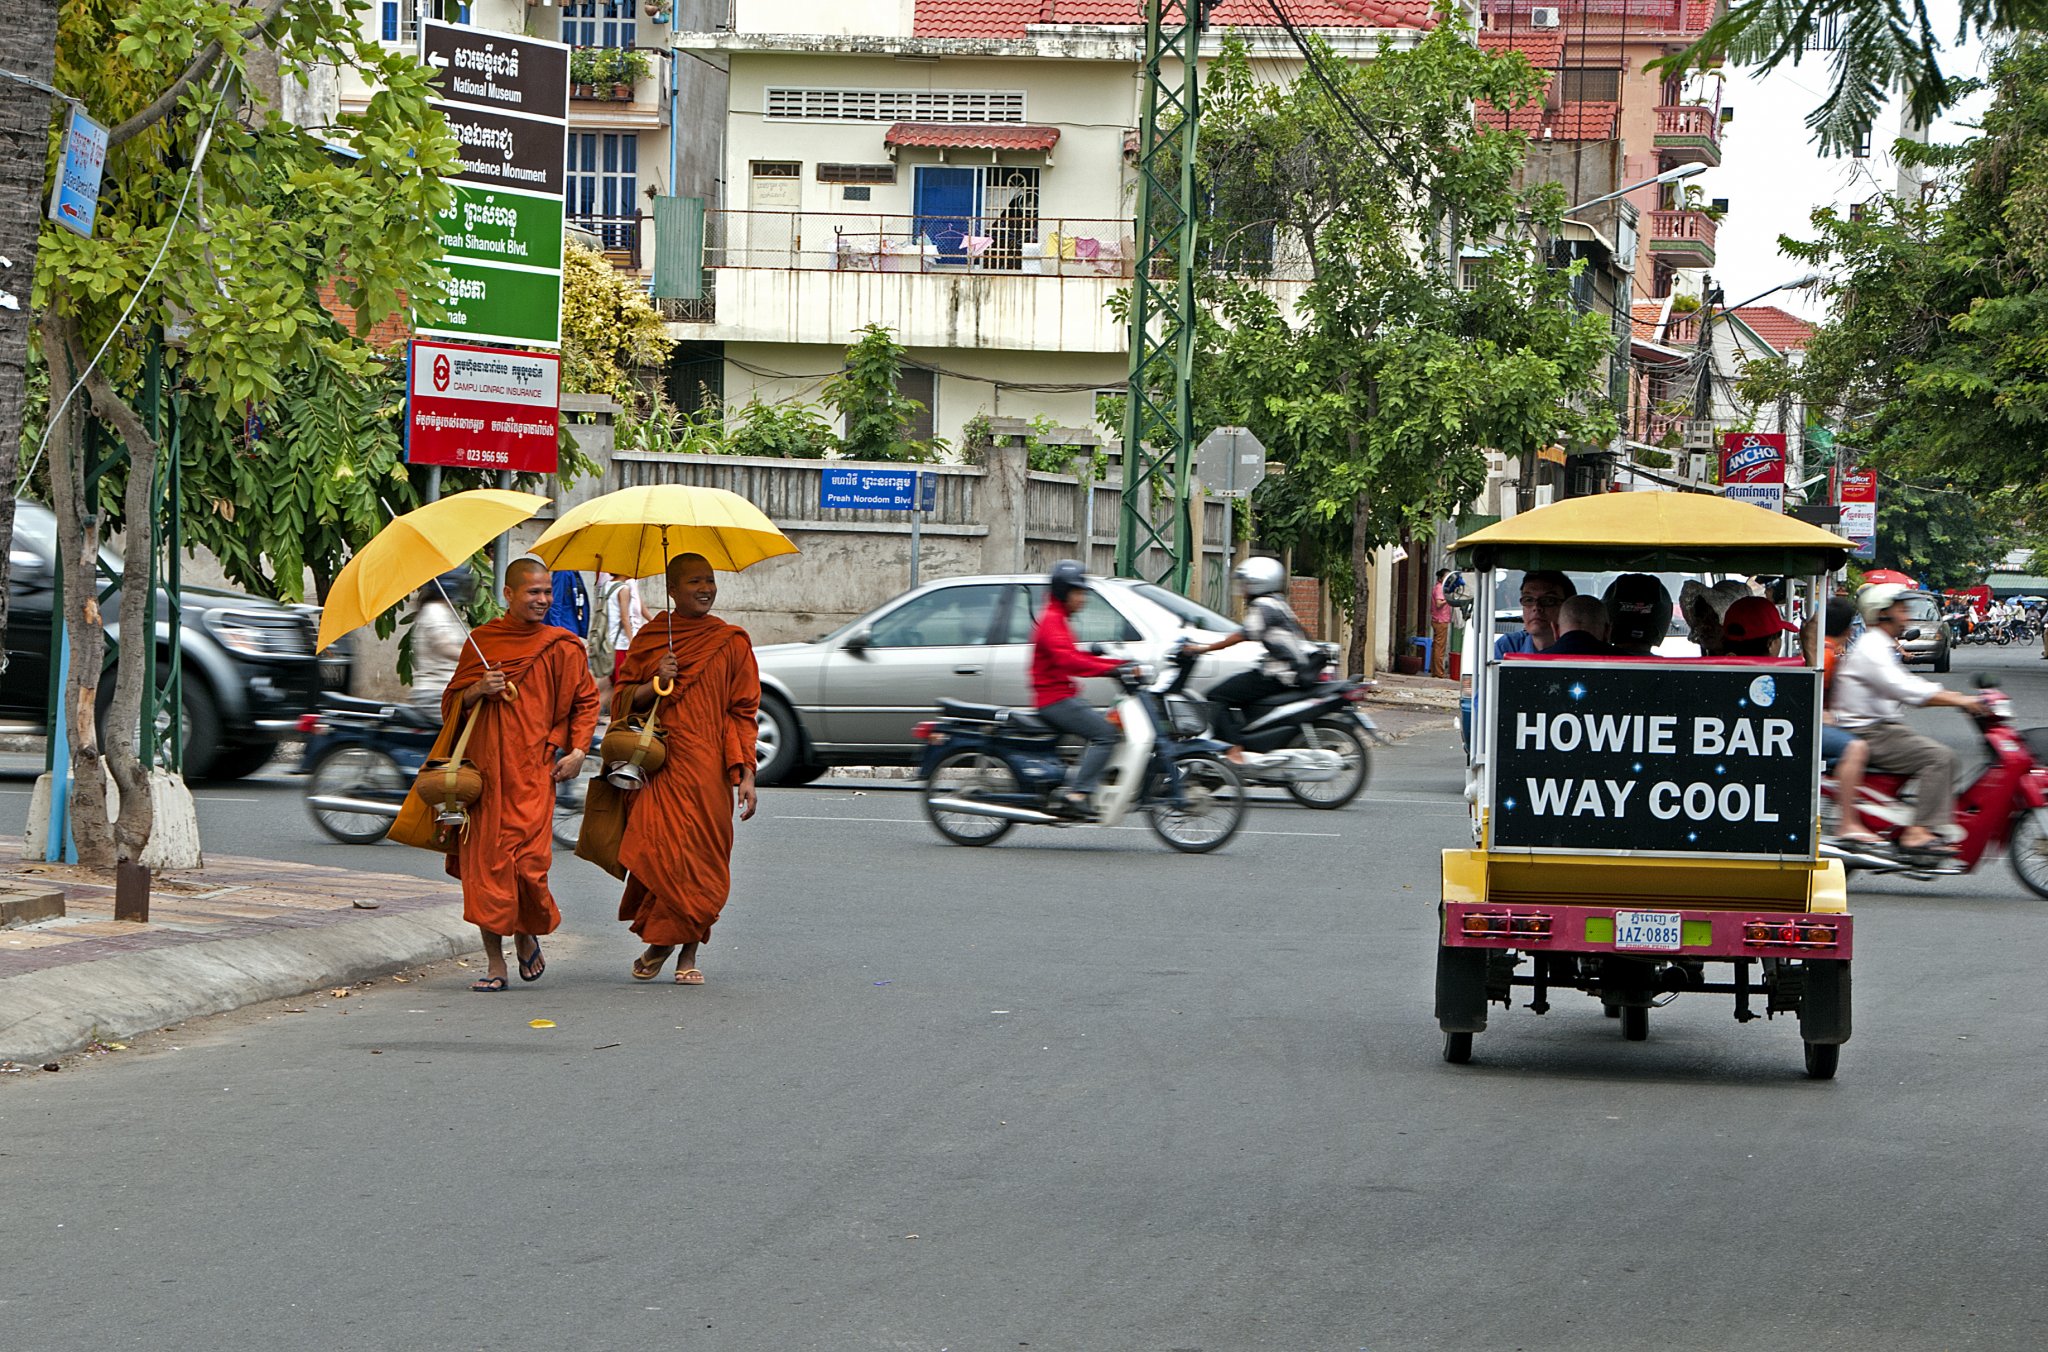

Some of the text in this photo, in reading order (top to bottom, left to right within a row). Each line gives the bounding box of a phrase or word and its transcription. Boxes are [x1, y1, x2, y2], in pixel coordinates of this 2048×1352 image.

[453, 76, 522, 103] National Museum
[448, 157, 547, 183] endence Monument
[465, 234, 506, 254] Sihanouk
[507, 239, 529, 256] Blvd.
[453, 381, 542, 398] CAMPU LONPAC INSURANCE
[466, 449, 509, 464] 023 966 966
[1846, 475, 1871, 484] ngkor
[827, 493, 851, 503] Preah
[853, 495, 890, 504] Norodom
[1516, 712, 1794, 757] HOWIE BAR
[1526, 778, 1779, 822] WAY COOL
